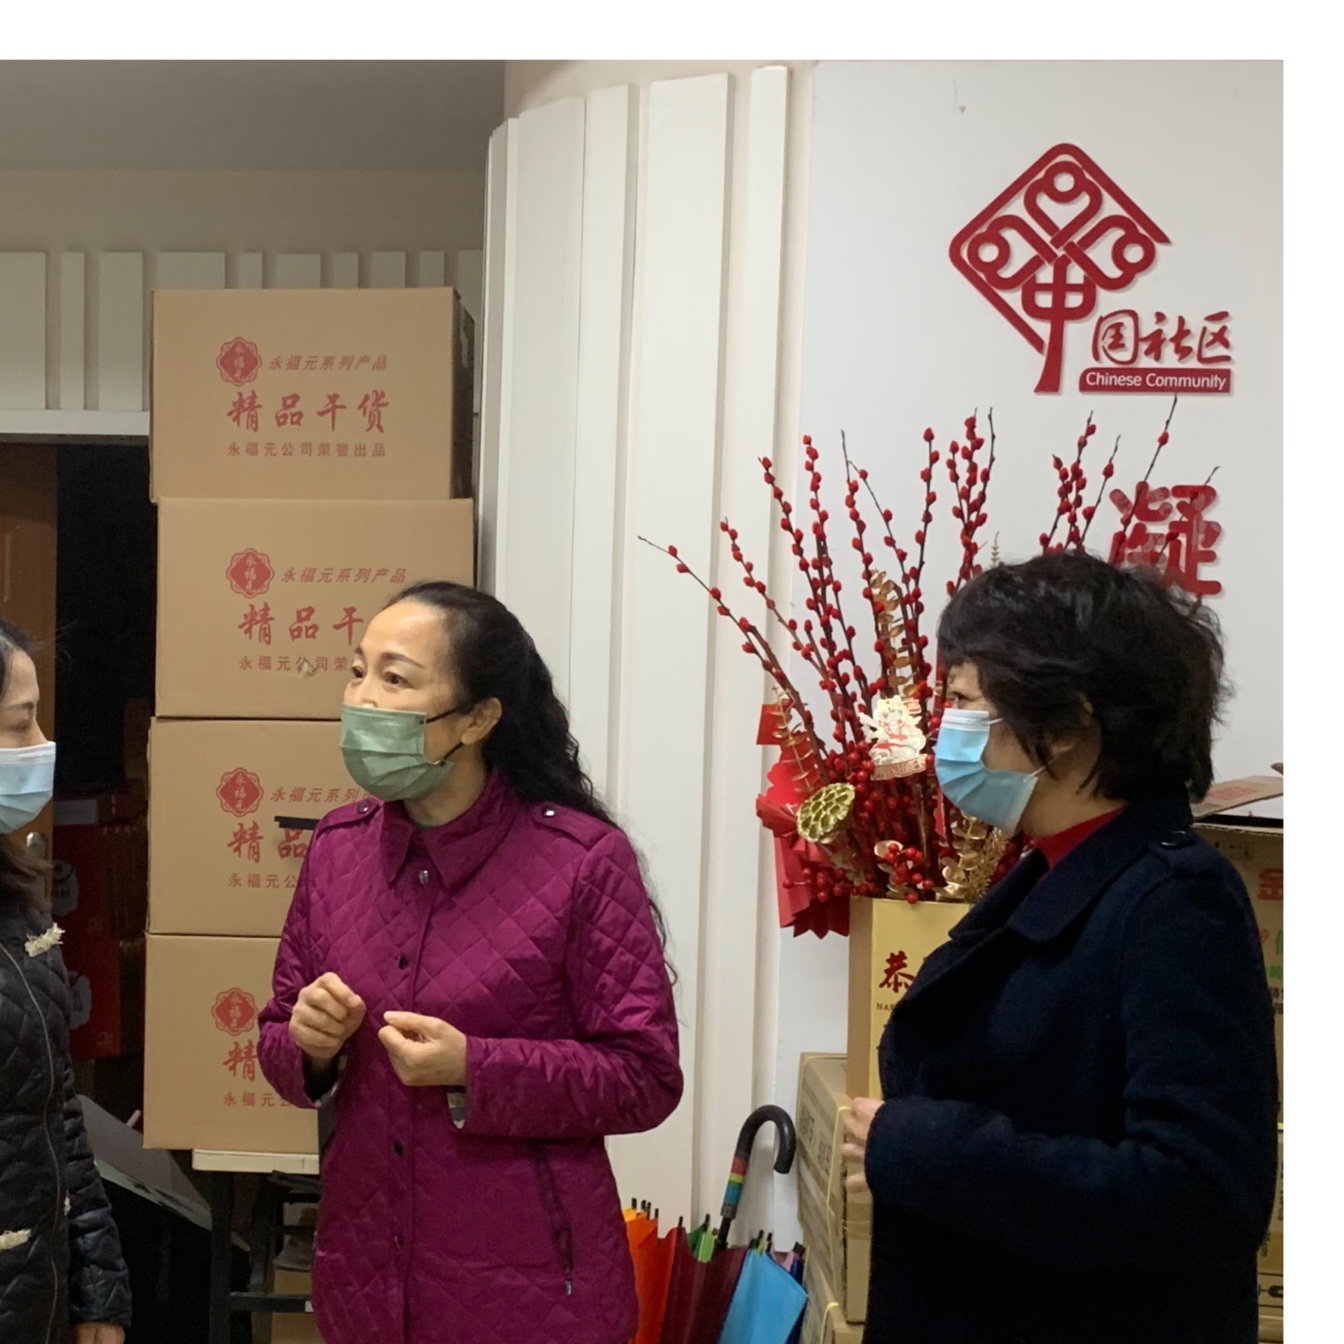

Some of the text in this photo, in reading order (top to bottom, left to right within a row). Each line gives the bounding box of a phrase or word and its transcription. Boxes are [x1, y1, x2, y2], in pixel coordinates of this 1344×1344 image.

[268, 355, 389, 371] 永福元系列产品
[1086, 371, 1227, 391] Chinese Community
[226, 389, 390, 434] 精品干货
[228, 442, 386, 457] 永福元公司荣誉出品
[280, 567, 407, 583] 永福元系列产品
[237, 601, 365, 646] 精品干
[878, 950, 916, 994] 恭
[222, 1039, 257, 1083] 精
